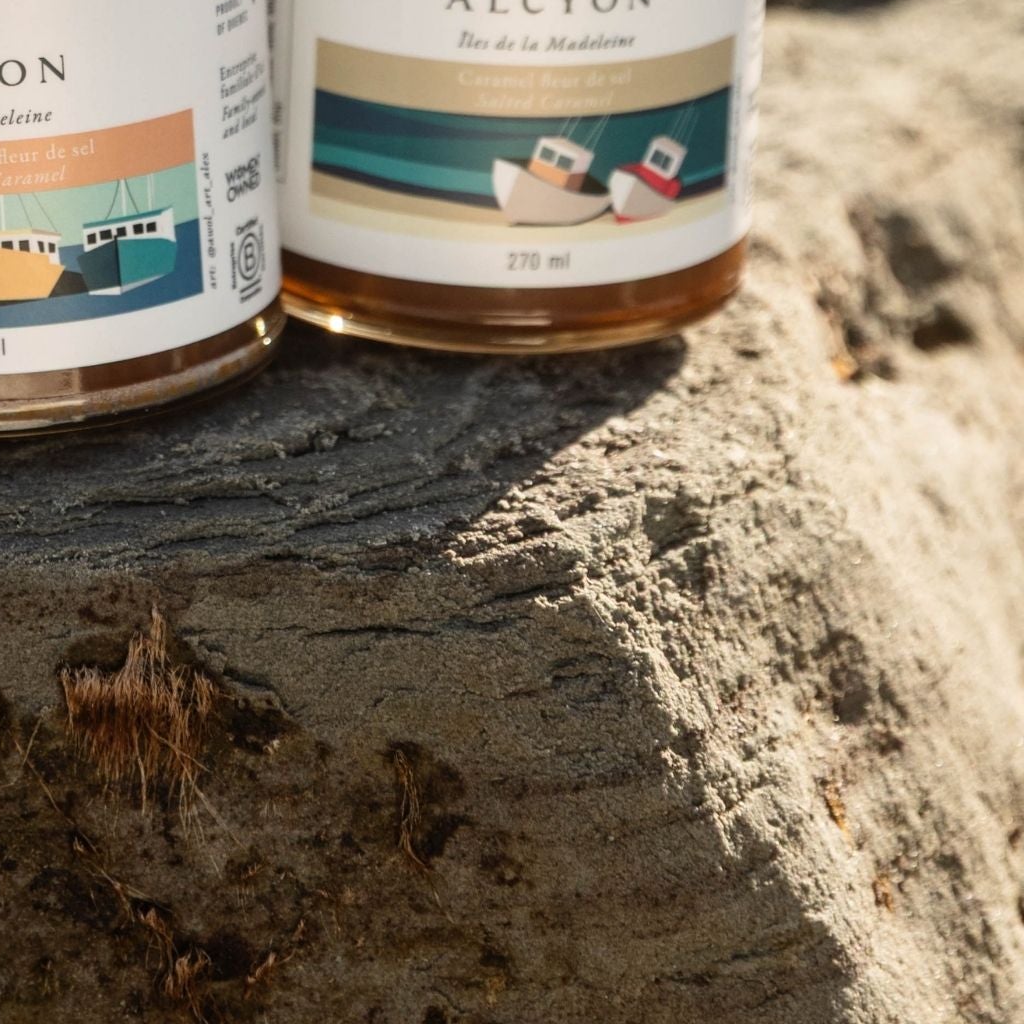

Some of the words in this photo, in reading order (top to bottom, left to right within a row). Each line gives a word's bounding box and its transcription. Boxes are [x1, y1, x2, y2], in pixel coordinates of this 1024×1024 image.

[494, 34, 516, 52] de
[521, 35, 539, 52] la
[545, 33, 636, 53] Madeleine
[46, 143, 66, 161] de
[72, 137, 95, 158] sel
[507, 251, 541, 271] 270
[549, 250, 571, 270] ml
